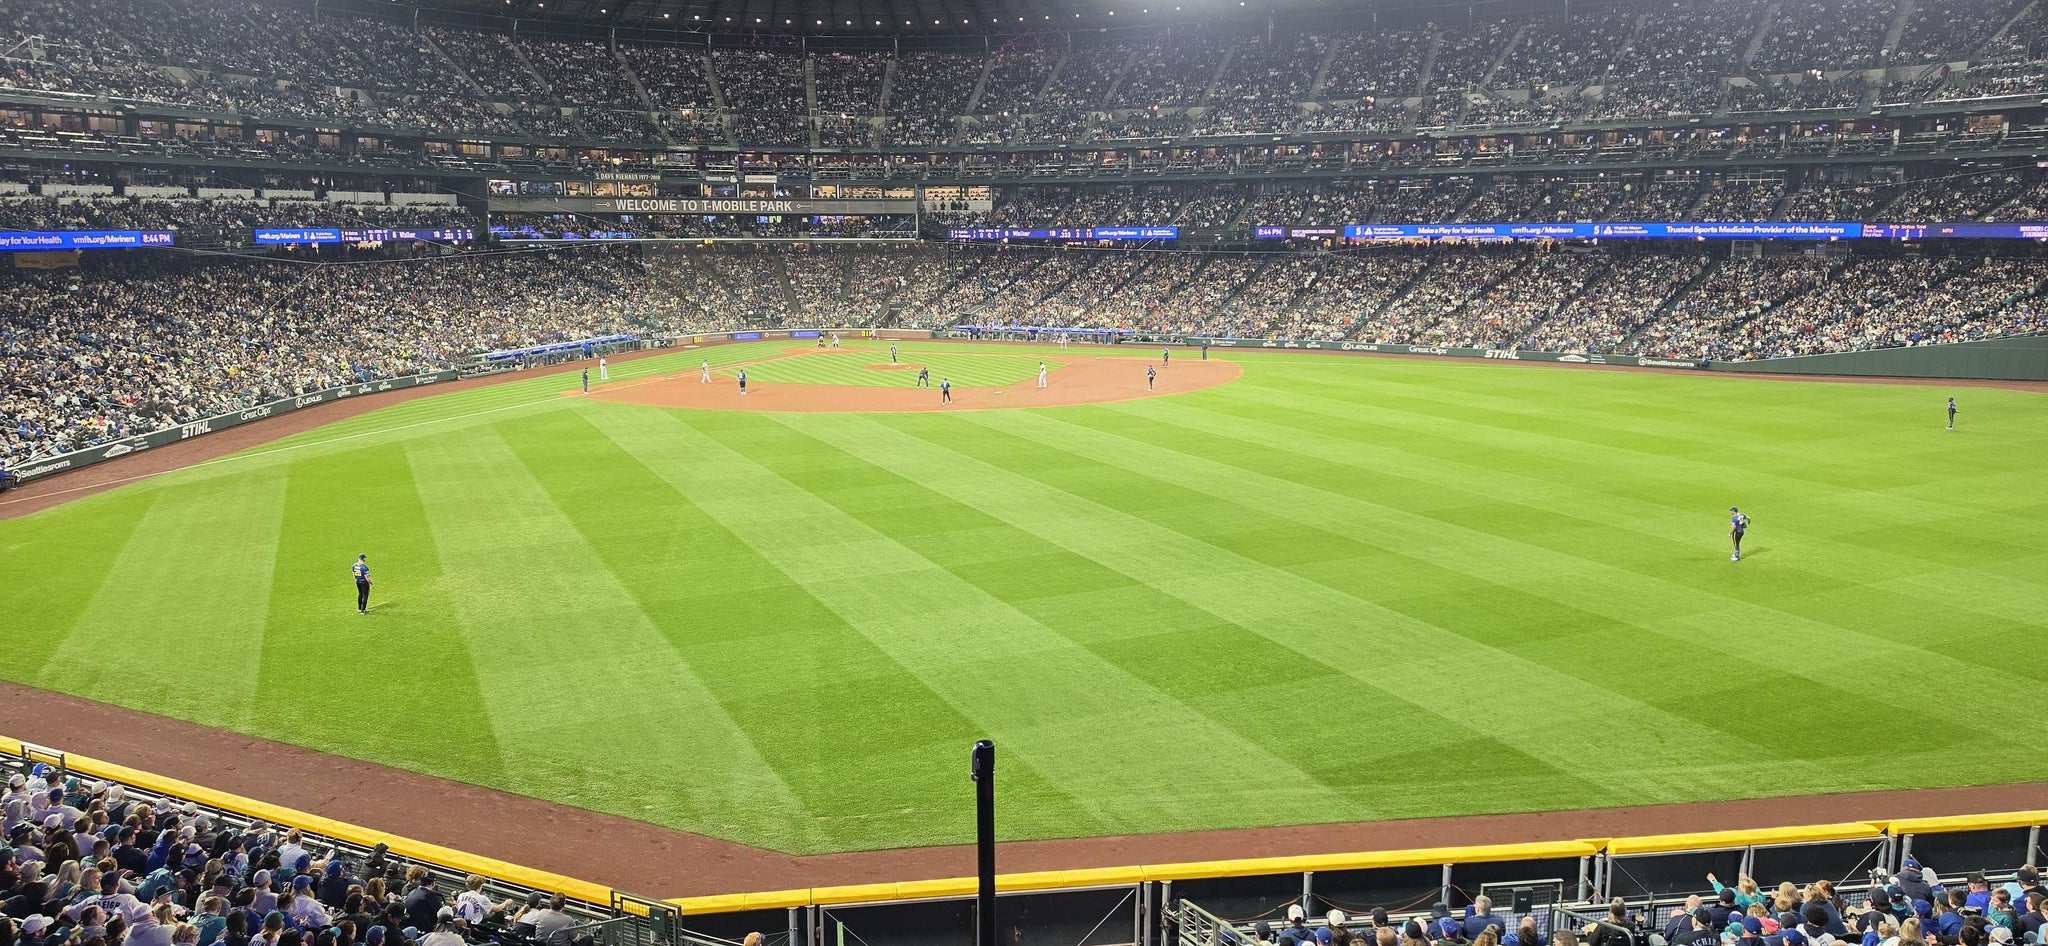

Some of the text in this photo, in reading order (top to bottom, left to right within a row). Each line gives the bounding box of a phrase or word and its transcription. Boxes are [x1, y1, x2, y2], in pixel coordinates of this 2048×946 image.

[616, 200, 792, 211] WELCOME TO T-MOBILE PARK
[1439, 227, 1451, 235] Play
[1694, 226, 1718, 234] Sports
[10, 236, 22, 244] for
[22, 236, 38, 244] Your
[38, 235, 62, 244] Health
[73, 234, 136, 245] vmfh.org/Mariners
[142, 234, 171, 243] 8:44 PM
[1484, 350, 1520, 359] STIHL
[1647, 359, 1694, 367] SeattleSPORTS
[303, 394, 323, 405] LEXUS
[240, 406, 272, 421] Great Clips
[182, 420, 212, 438] STIHL
[20, 460, 71, 478] SeattleSPORTS
[457, 903, 468, 918] 4
